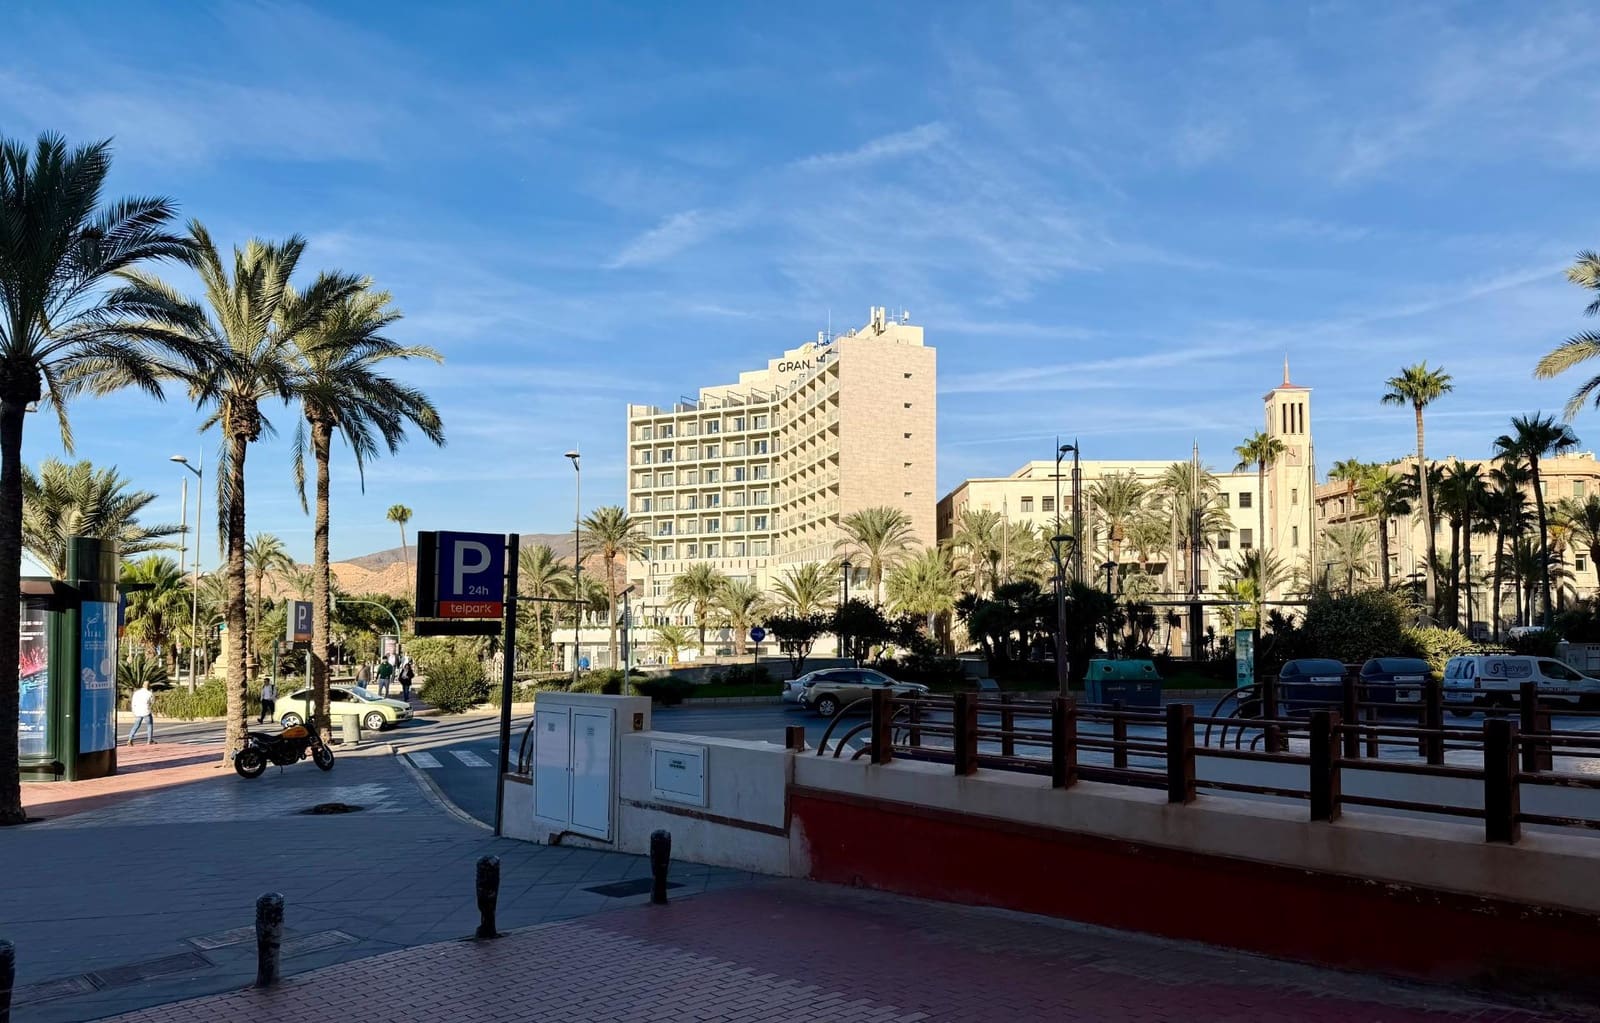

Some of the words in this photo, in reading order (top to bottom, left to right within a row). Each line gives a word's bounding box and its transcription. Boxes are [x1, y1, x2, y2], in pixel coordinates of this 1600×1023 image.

[777, 359, 810, 373] GRAN
[453, 540, 491, 595] P
[468, 585, 489, 595] 24h
[450, 603, 492, 614] telpark
[298, 605, 307, 630] P
